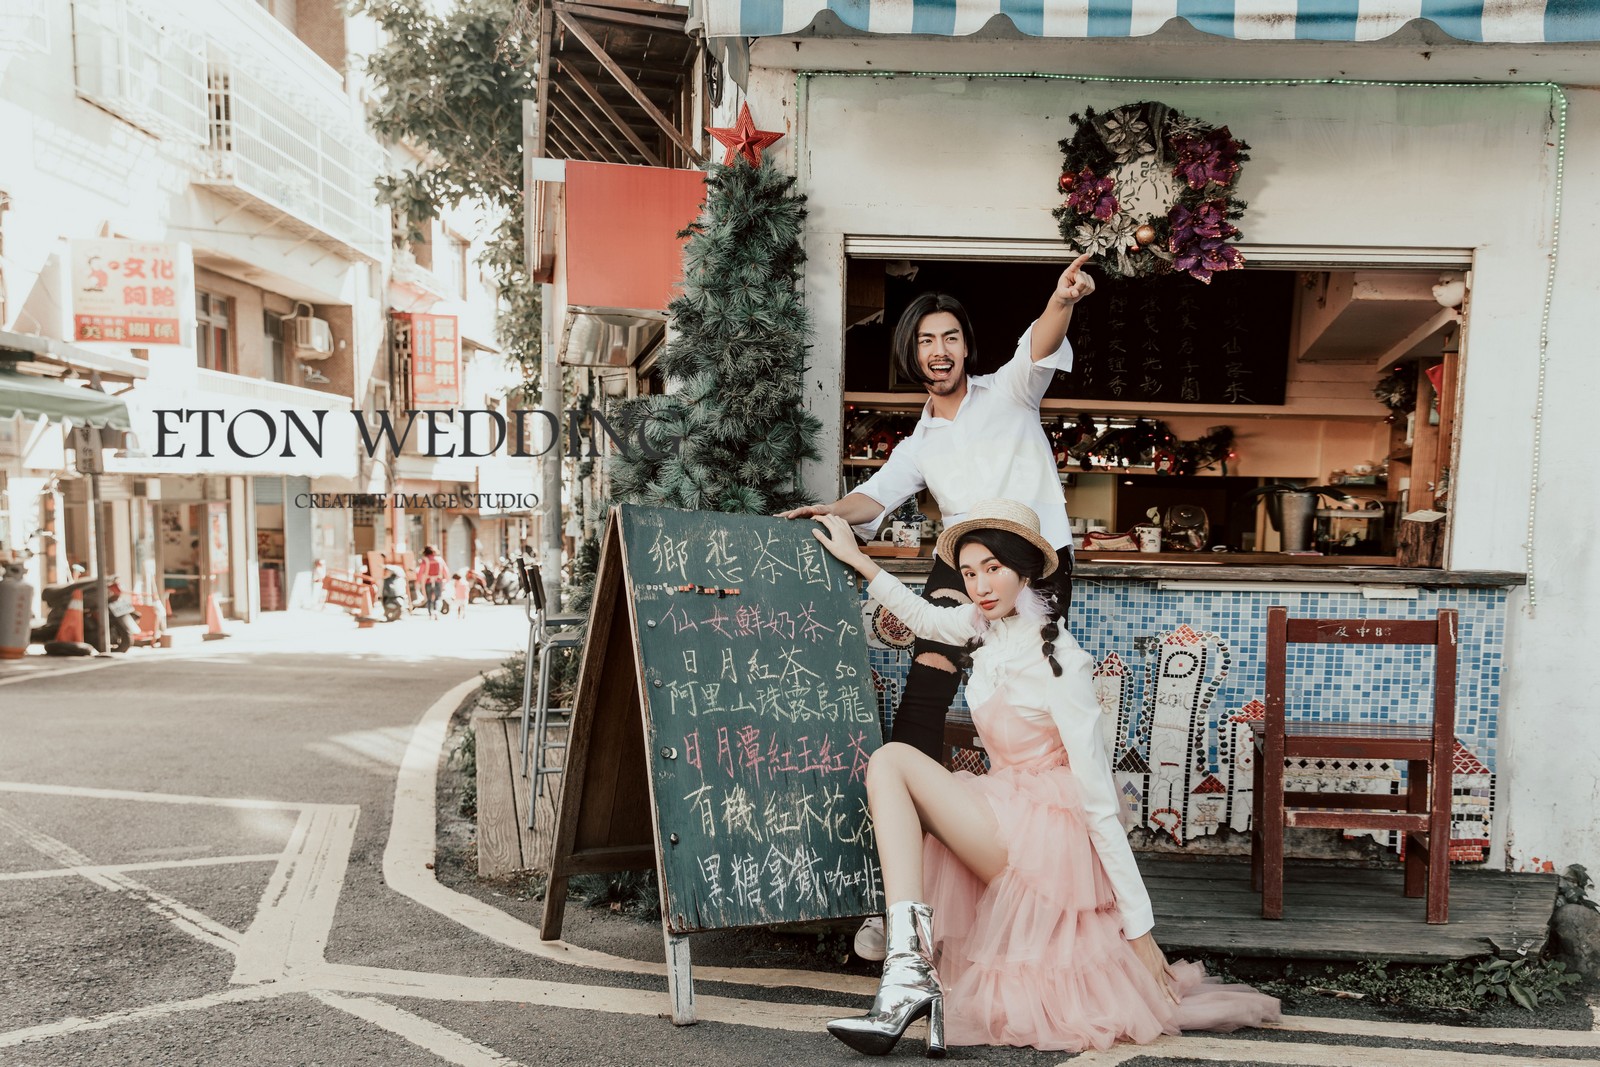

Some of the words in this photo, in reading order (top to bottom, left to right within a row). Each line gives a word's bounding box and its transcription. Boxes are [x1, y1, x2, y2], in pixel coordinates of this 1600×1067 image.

[659, 602, 835, 643] 仙女鮮奶茶
[836, 619, 859, 646] 70
[682, 645, 822, 686] 日月紅茶
[835, 660, 857, 680] 50
[683, 725, 870, 789] 日月潭紅玉紅茶
